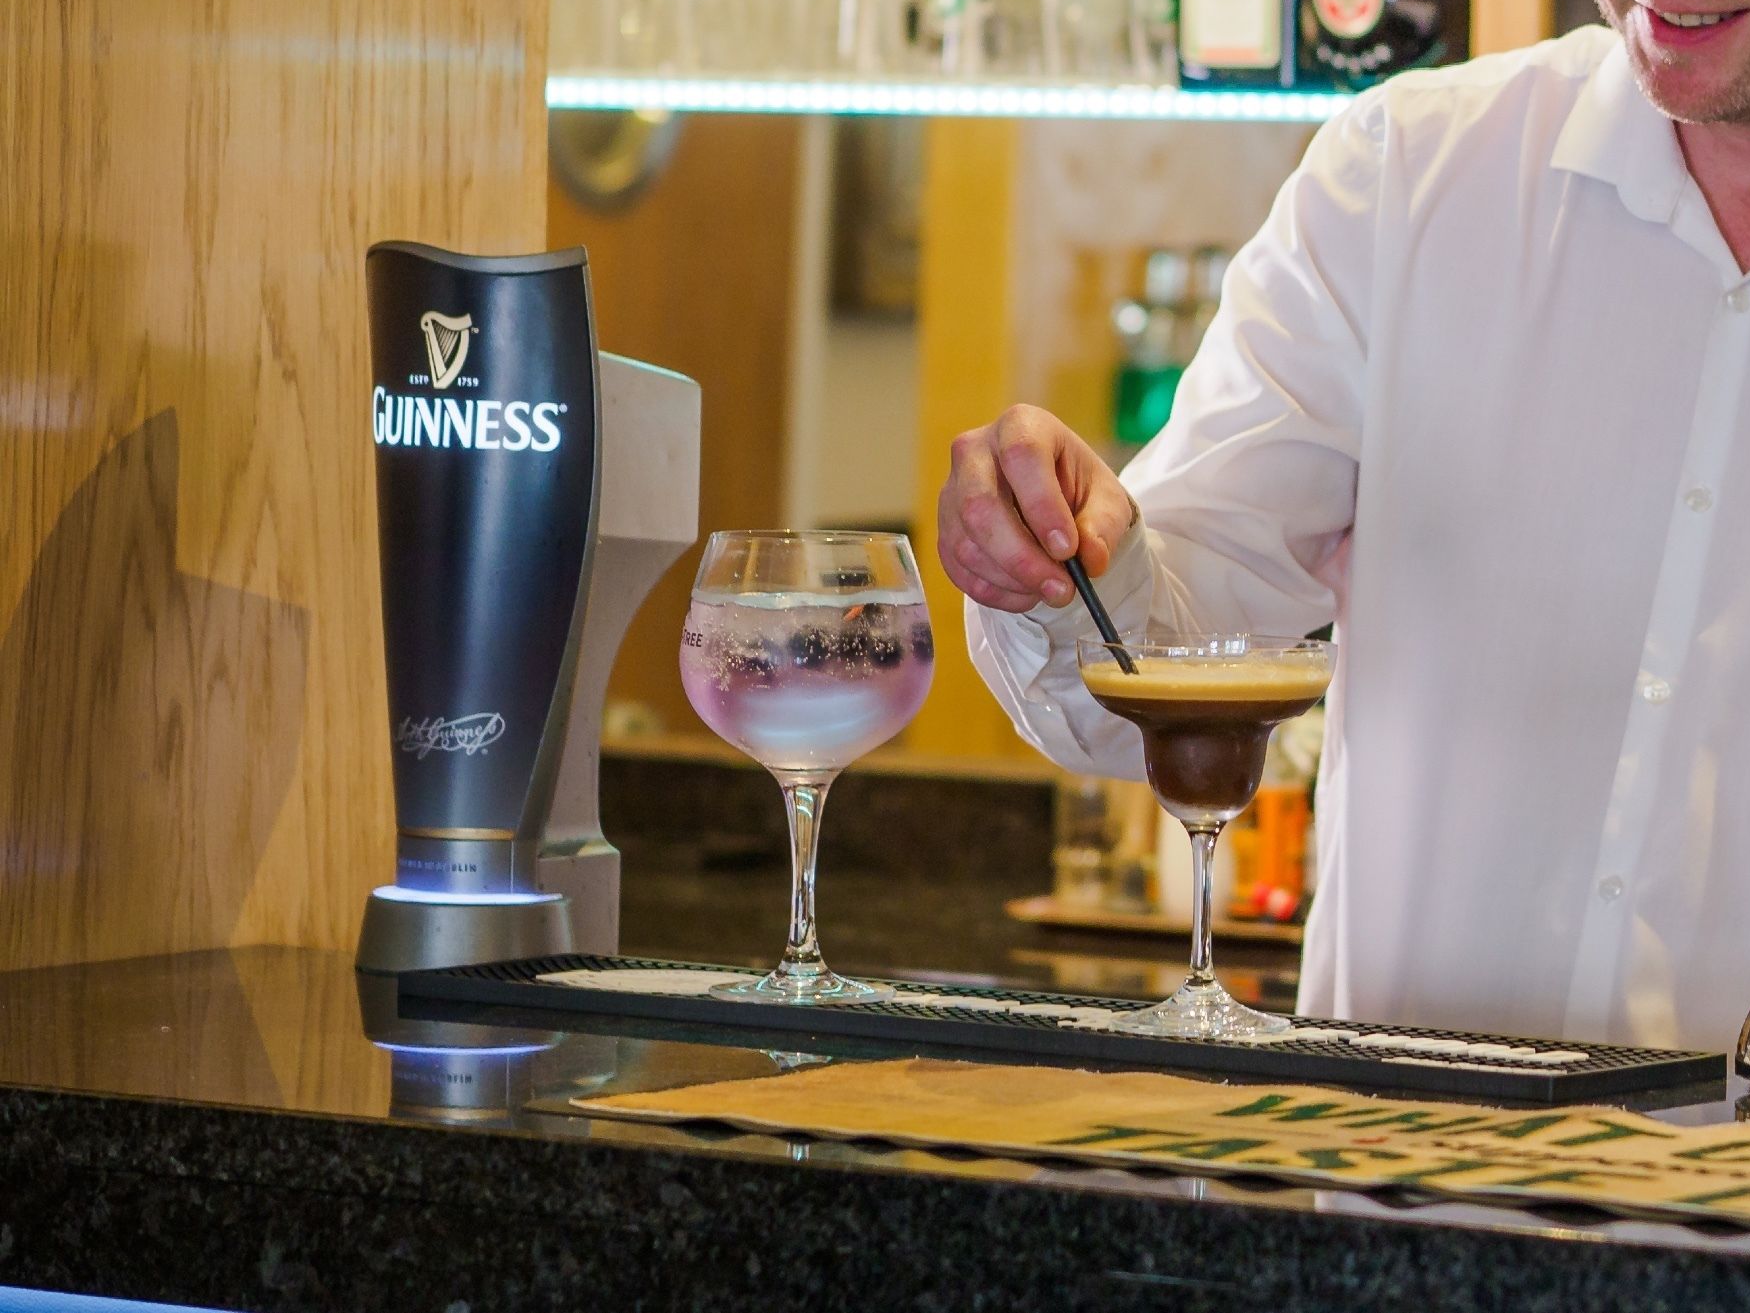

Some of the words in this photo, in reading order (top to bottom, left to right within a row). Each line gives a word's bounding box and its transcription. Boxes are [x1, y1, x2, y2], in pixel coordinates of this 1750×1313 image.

[457, 377, 479, 387] 1759
[373, 385, 563, 452] GUINNESS
[1217, 1093, 1676, 1147] WHAT
